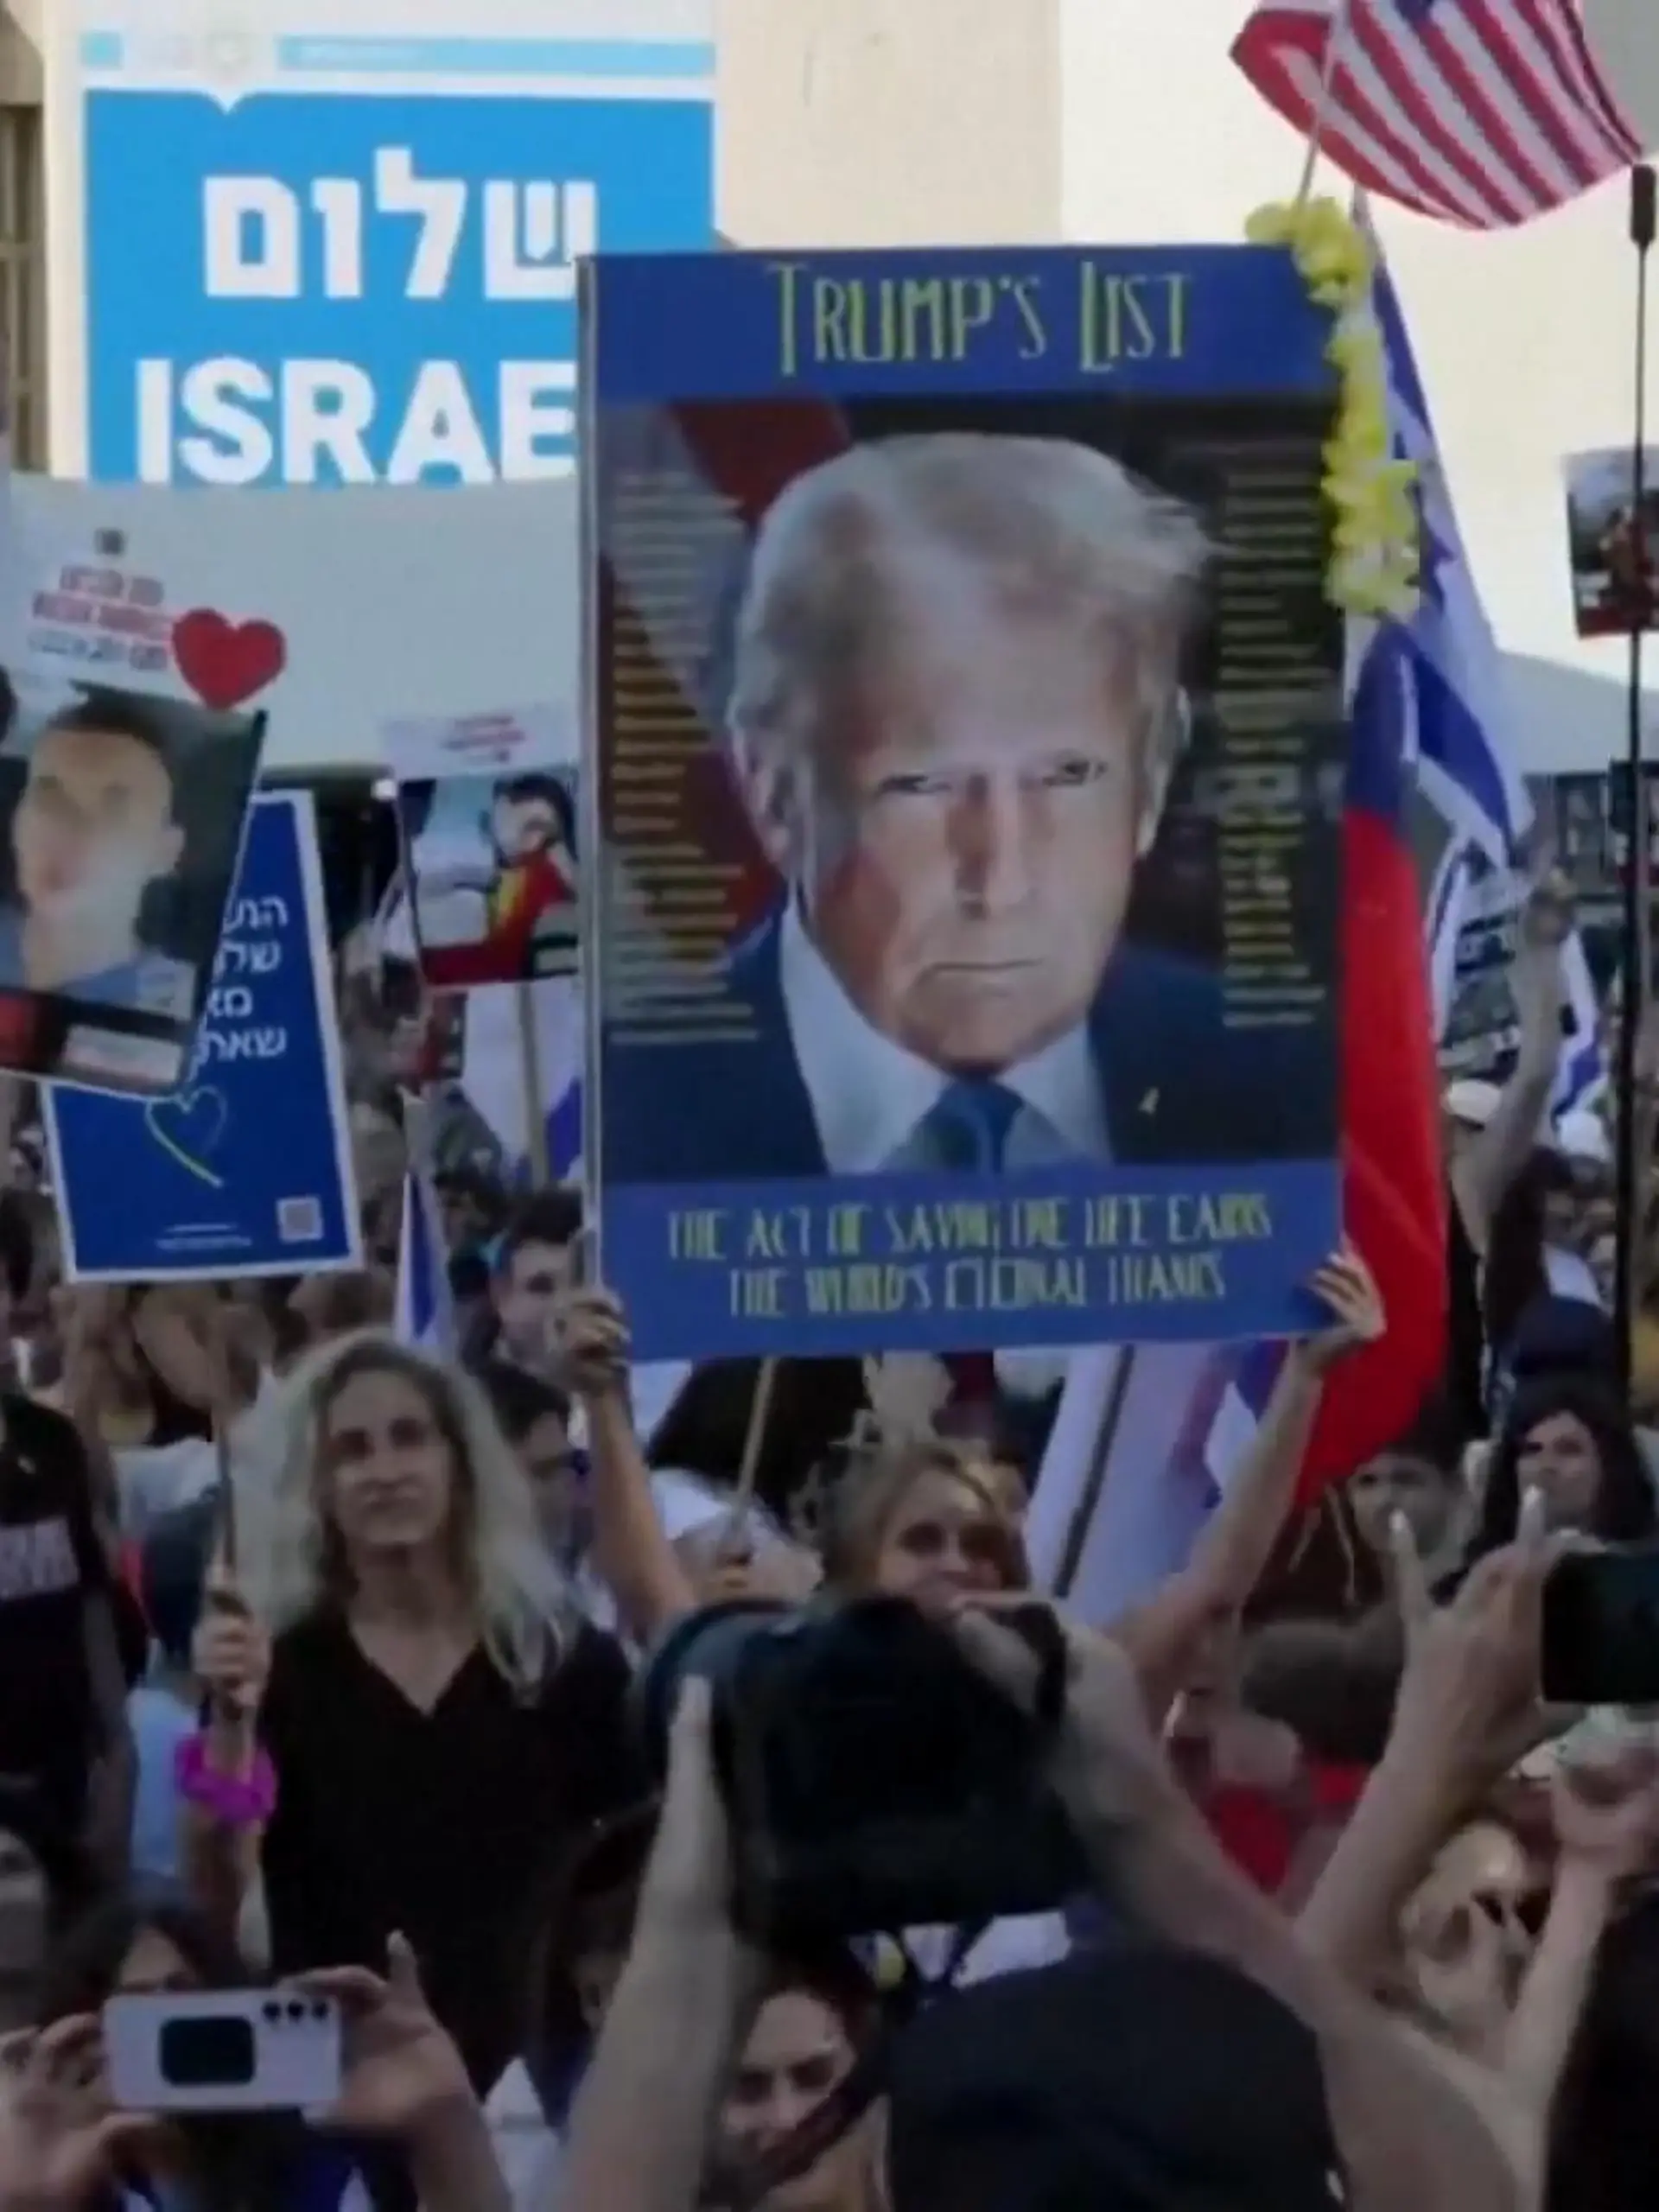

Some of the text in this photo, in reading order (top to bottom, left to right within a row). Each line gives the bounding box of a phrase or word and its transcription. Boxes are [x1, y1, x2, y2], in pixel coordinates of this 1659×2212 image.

[204, 147, 597, 300] שלום
[766, 260, 1192, 377] TRUMP'S LIST
[136, 356, 576, 486] ISRAE
[884, 1198, 1002, 1253] SAV
